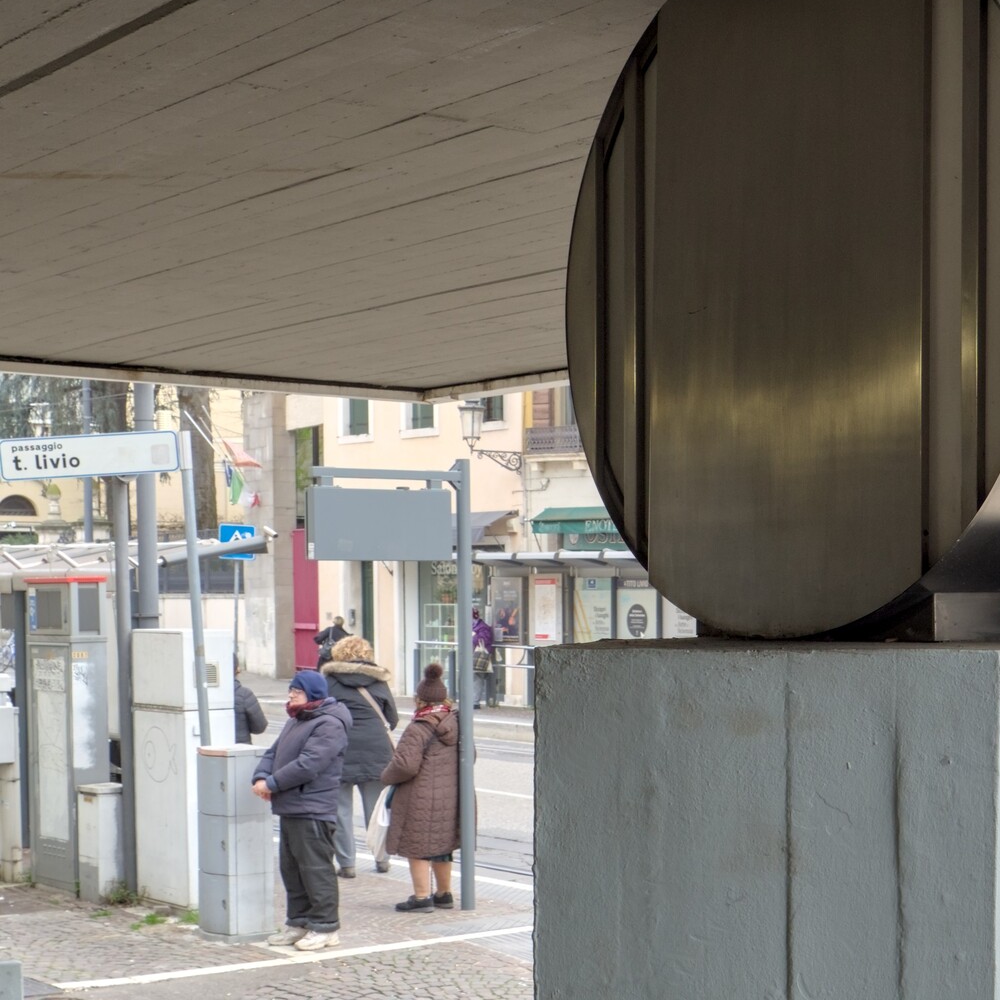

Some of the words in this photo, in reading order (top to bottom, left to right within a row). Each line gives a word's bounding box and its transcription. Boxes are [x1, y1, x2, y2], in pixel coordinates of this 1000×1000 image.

[11, 442, 63, 453] passaggio
[13, 455, 28, 471] t.
[35, 453, 80, 470] livio
[584, 520, 618, 532] ENOT
